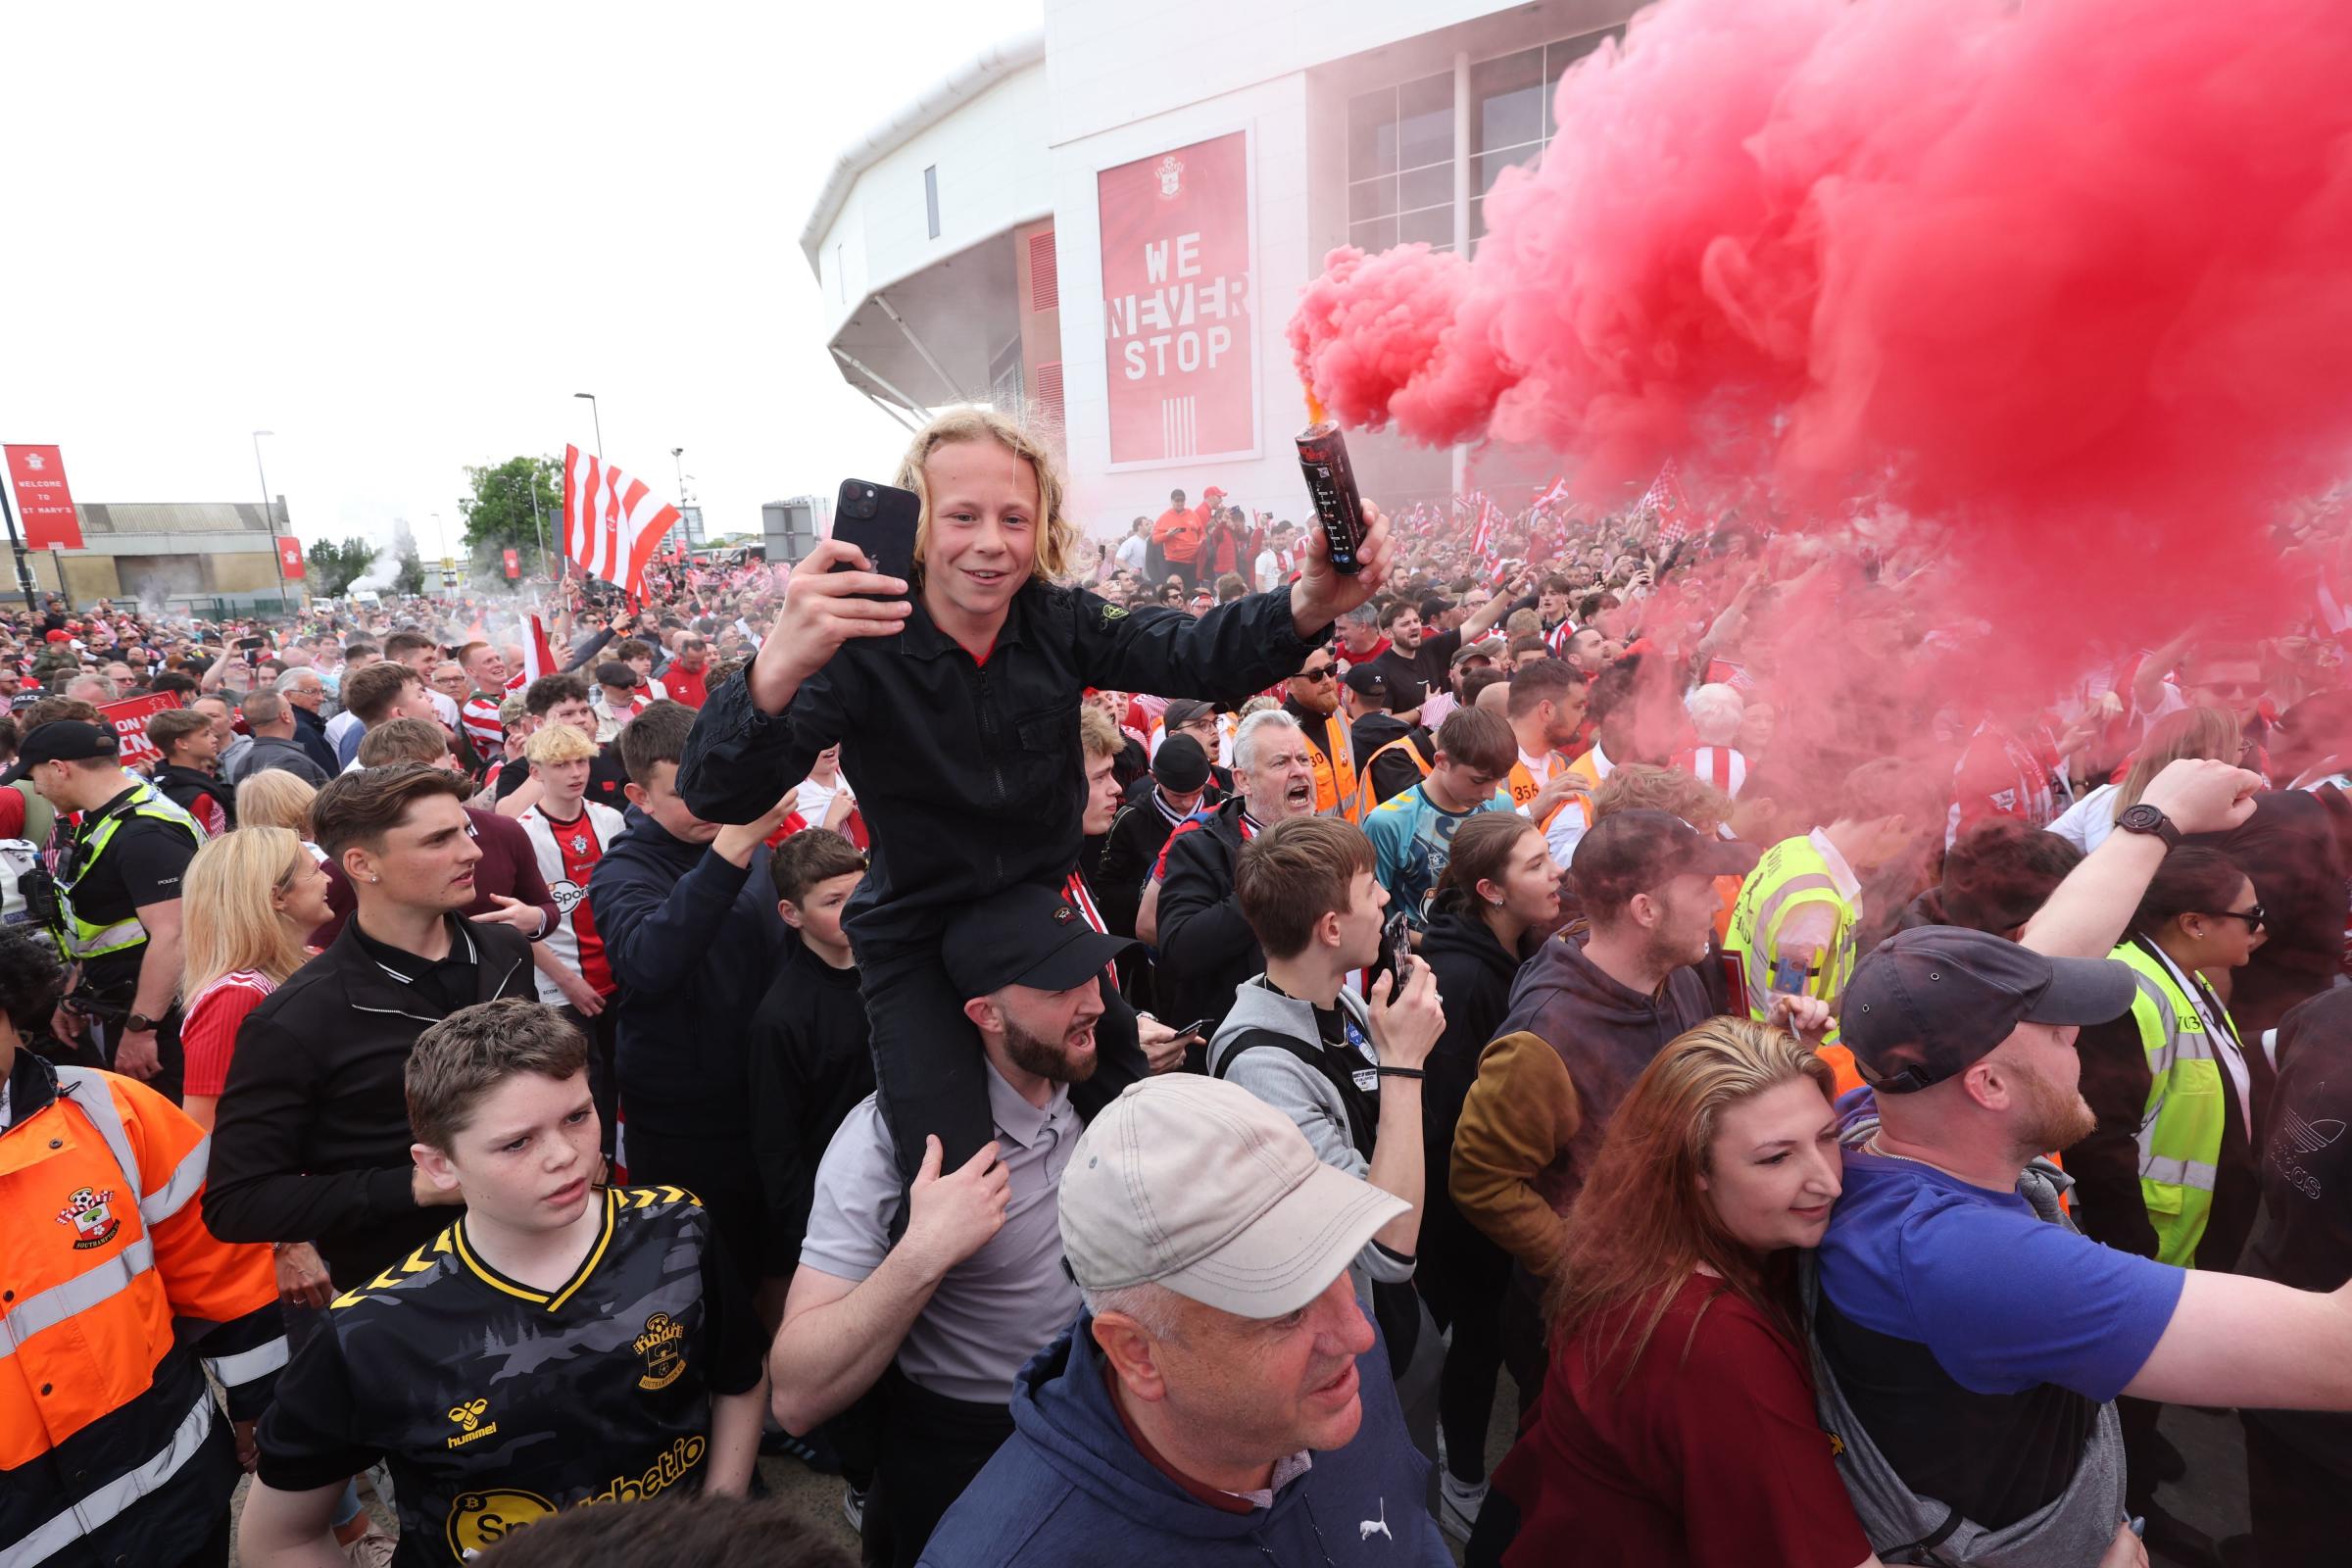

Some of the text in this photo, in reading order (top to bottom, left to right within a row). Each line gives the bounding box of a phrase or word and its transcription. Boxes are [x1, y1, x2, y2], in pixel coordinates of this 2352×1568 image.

[1145, 231, 1201, 284] WE
[1104, 272, 1250, 339] NEVER
[1124, 325, 1232, 380] STOP
[13, 695, 41, 704] POLICE
[115, 716, 142, 733] ON
[1309, 752, 1325, 768] 30
[1514, 783, 1541, 802] 356
[157, 876, 180, 886] POLICE
[448, 1421, 497, 1449] hummel
